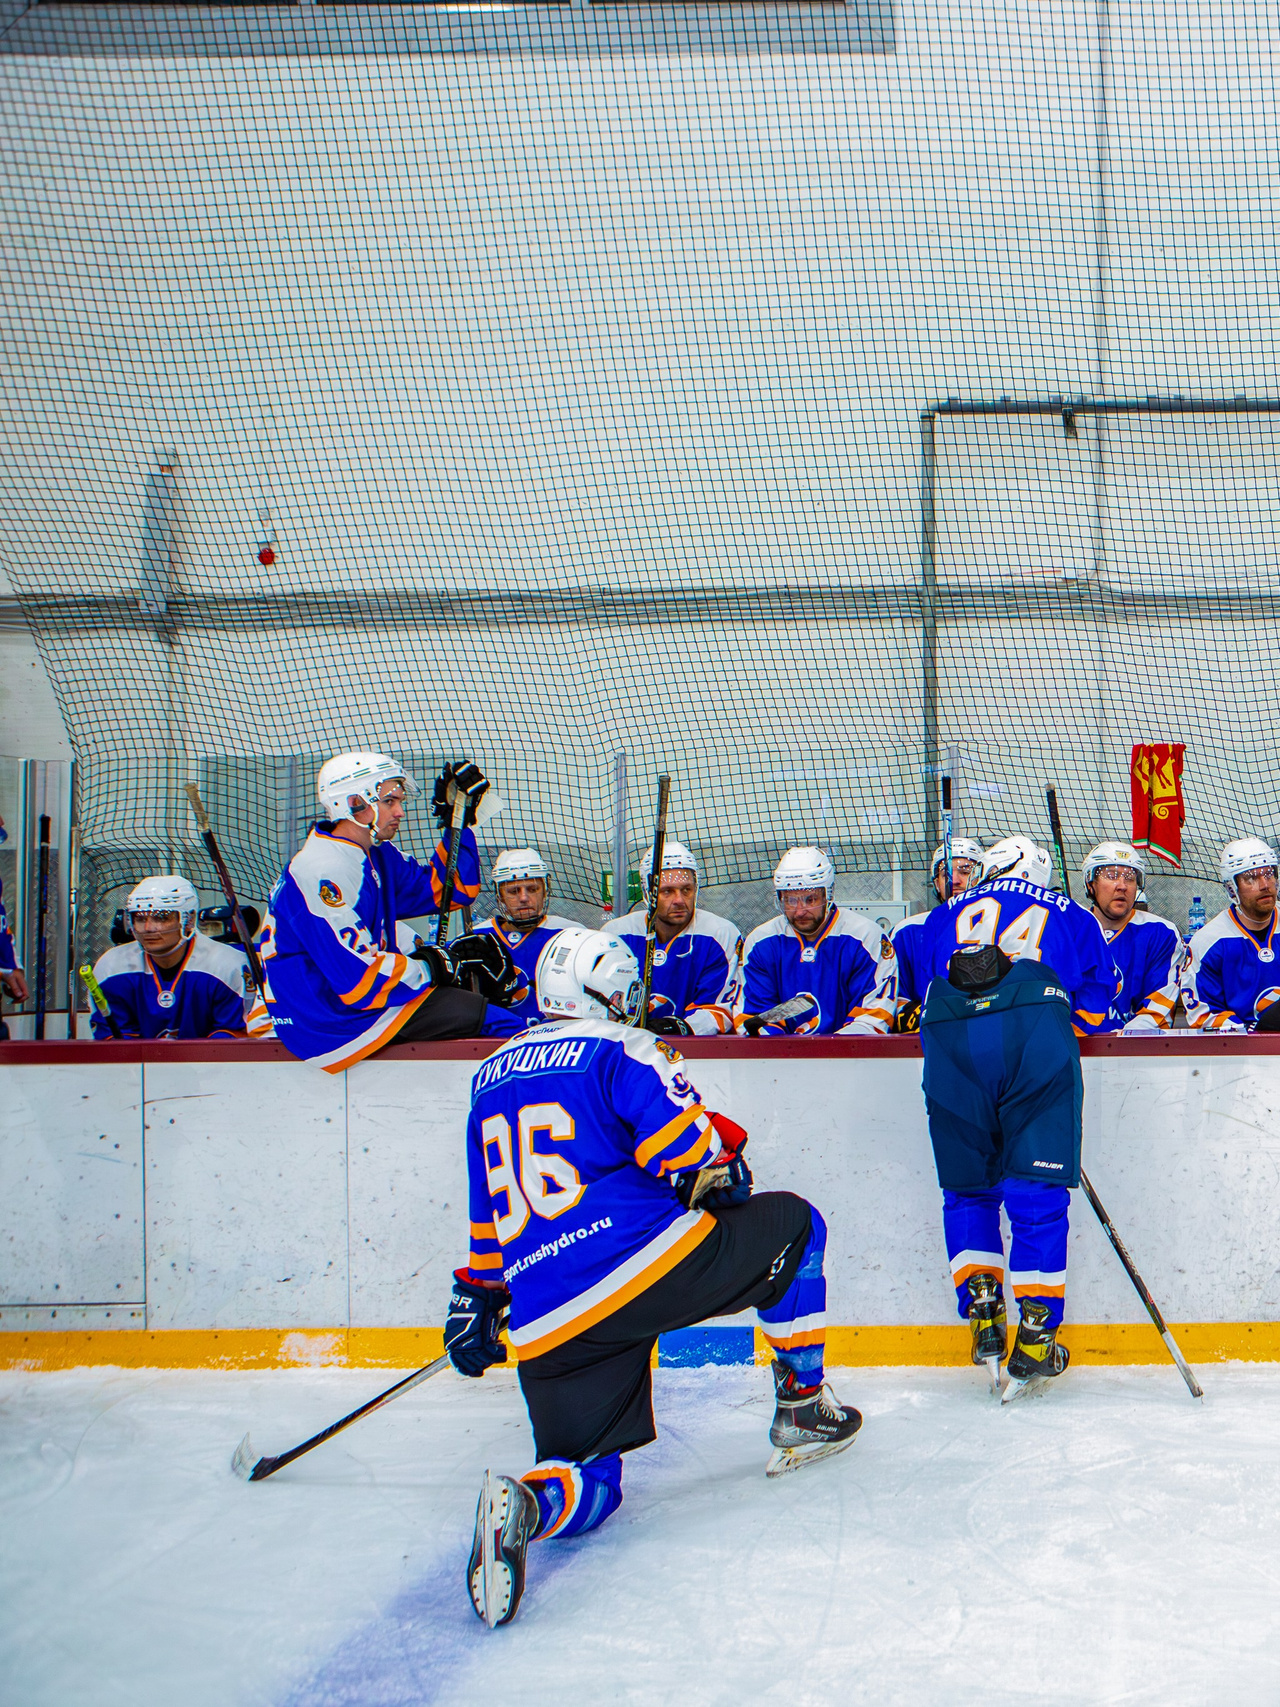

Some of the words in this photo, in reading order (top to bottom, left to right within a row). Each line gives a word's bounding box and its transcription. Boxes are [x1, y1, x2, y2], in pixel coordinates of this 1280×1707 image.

[947, 879, 1071, 912] МЕЗИНЦЕВ
[954, 896, 1050, 962] 94
[474, 1041, 587, 1094] КУКУШКИН
[481, 1101, 589, 1247] 96
[502, 1215, 614, 1284] sport.rushydro.ru
